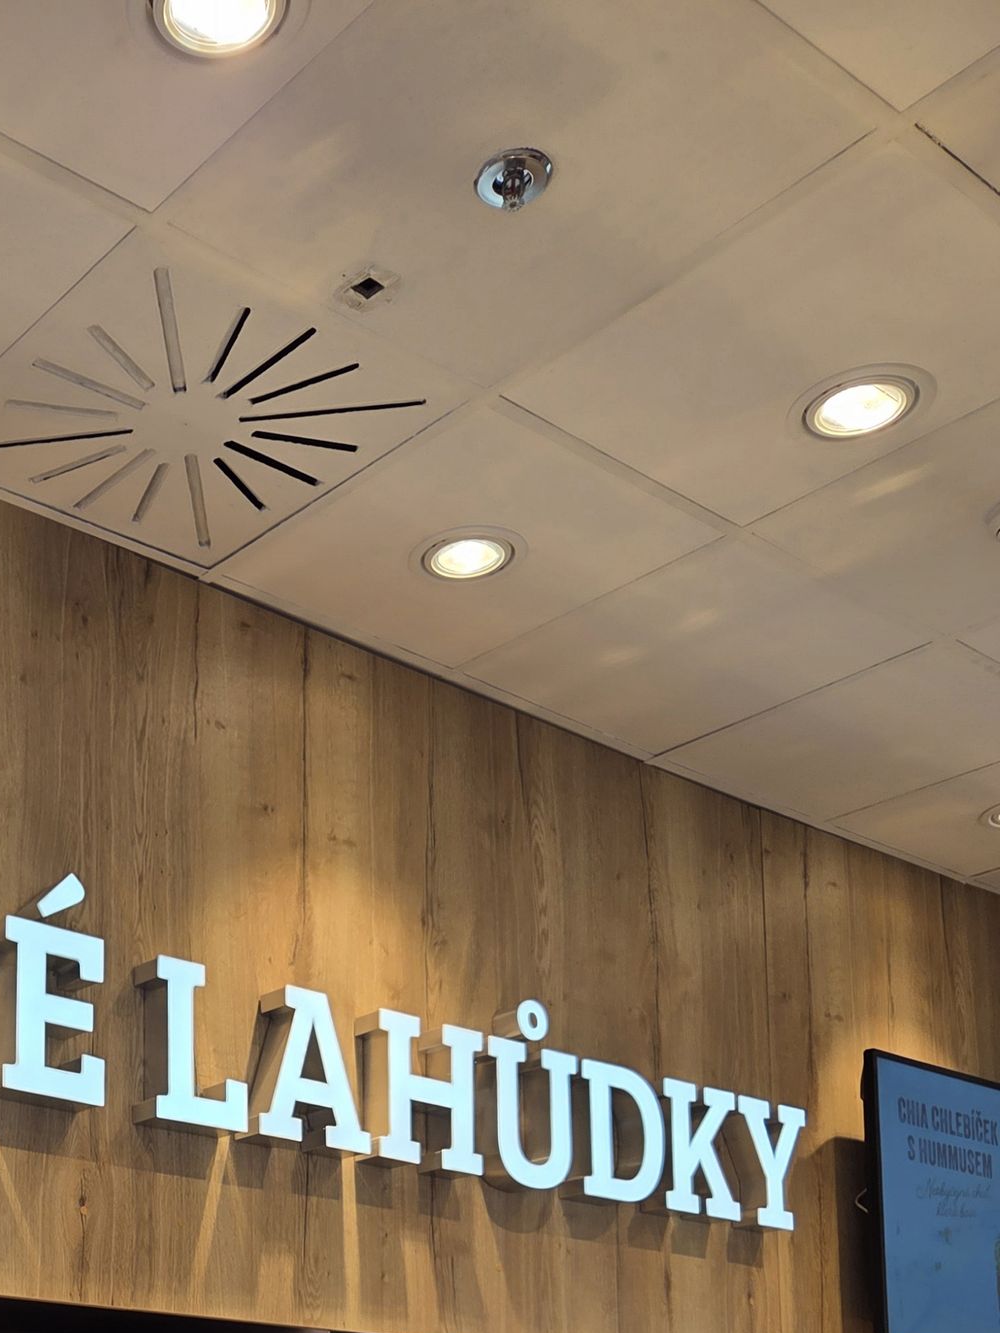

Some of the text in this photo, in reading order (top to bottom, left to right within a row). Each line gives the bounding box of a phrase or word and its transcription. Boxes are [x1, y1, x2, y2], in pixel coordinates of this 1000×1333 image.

[155, 954, 806, 1231] LAHŮDKY
[897, 1096, 999, 1147] CHIA CHLEBÍČEK
[907, 1135, 993, 1180] S HUMMUSEM
